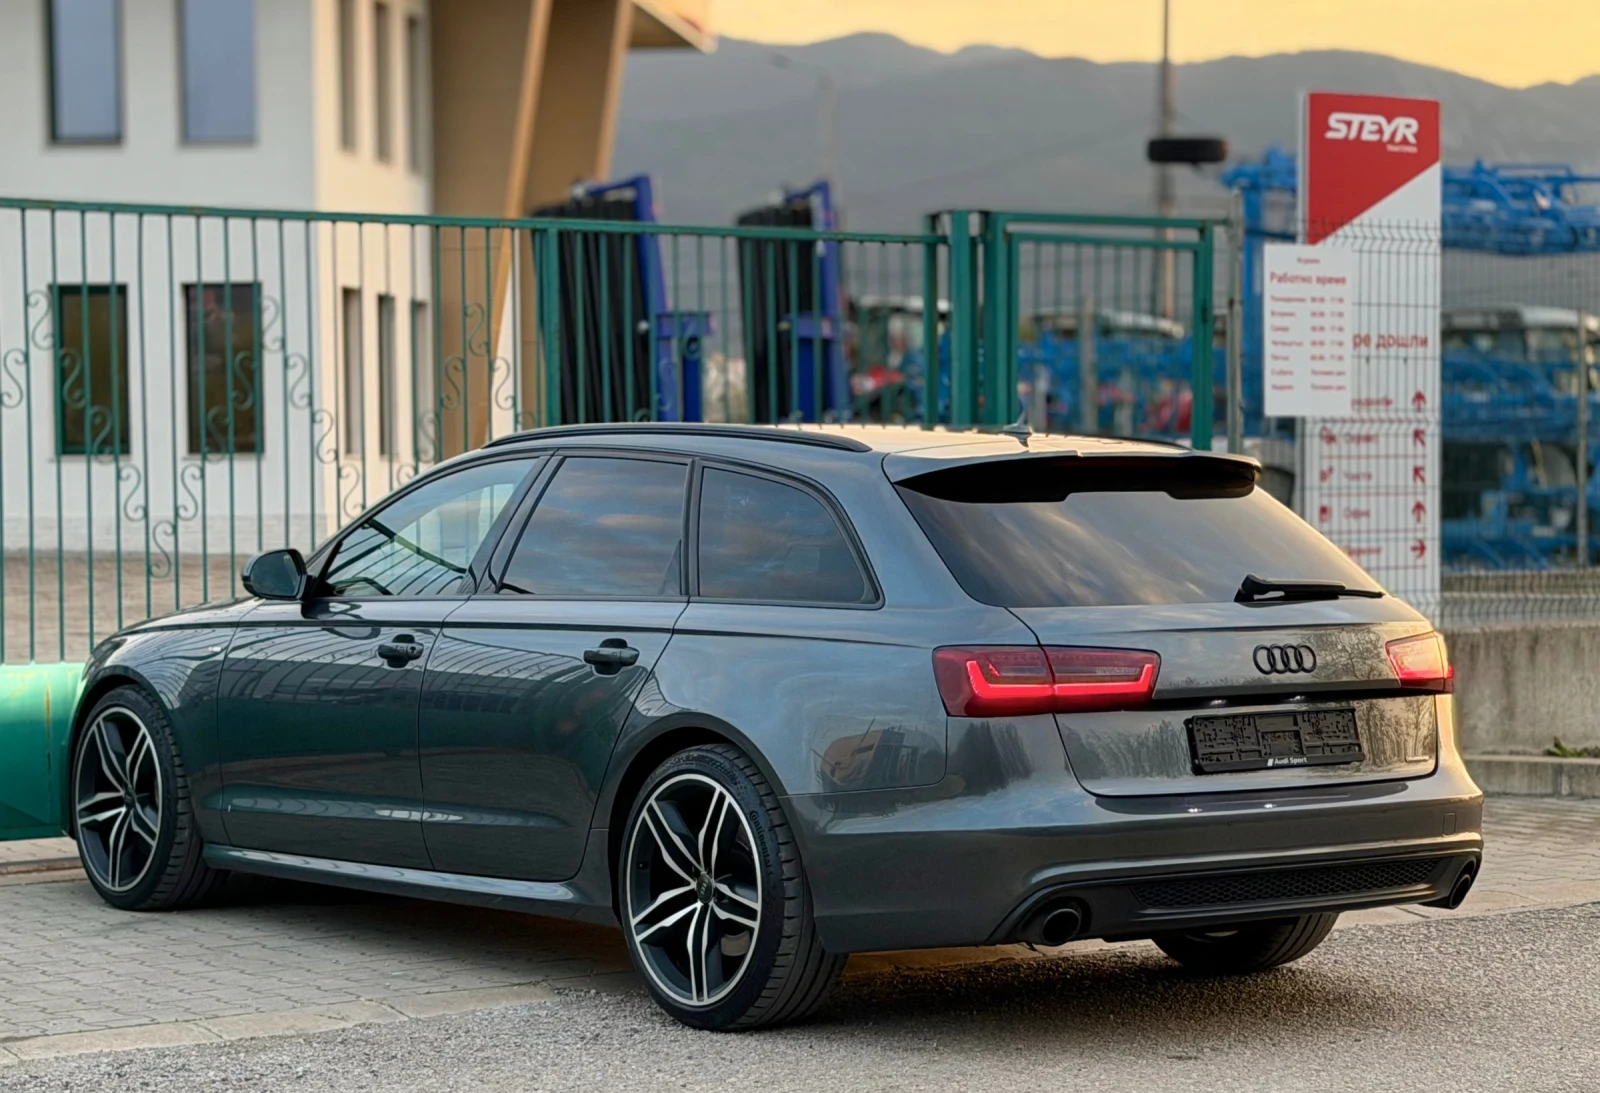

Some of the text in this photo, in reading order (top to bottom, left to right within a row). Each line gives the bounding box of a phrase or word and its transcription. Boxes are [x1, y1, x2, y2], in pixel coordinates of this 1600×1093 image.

[1324, 111, 1419, 144] STEYR
[1270, 271, 1313, 285] Работно
[1274, 756, 1307, 765] Audi Sport
[749, 810, 772, 868] Continental
